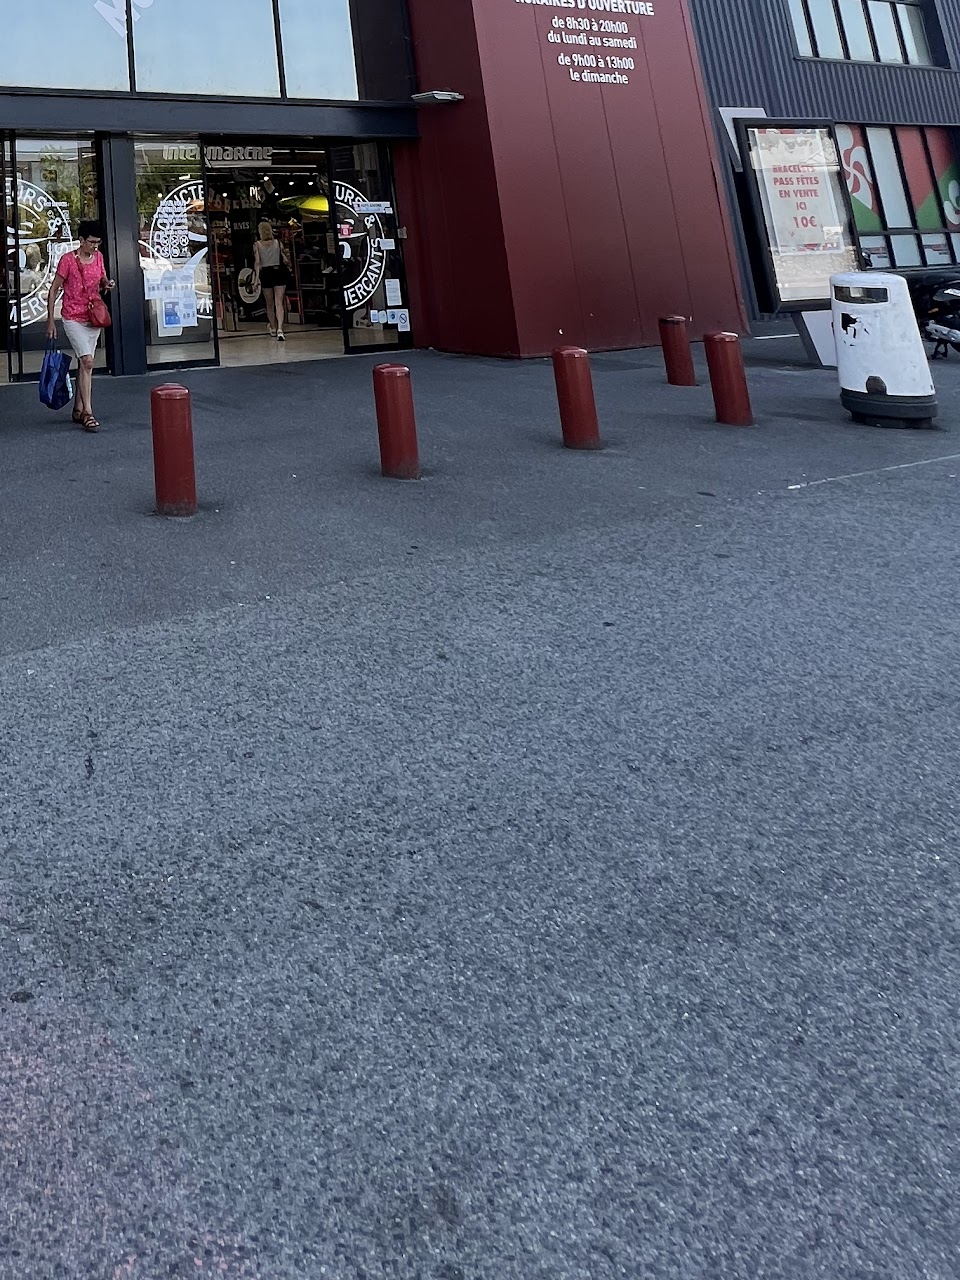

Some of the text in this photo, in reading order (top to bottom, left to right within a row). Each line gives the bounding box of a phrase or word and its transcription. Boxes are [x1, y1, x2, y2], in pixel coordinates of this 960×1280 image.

[551, 16, 629, 34] de 8h30 à 20h00
[547, 30, 638, 49] du lundi au samedi
[558, 53, 635, 70] de 9h00 à 13h00
[569, 68, 629, 85] le dimanche
[773, 174, 820, 186] PASS FÊTES
[778, 188, 820, 198] EN VENTE
[796, 202, 807, 210] ICI
[793, 215, 818, 228] 10€
